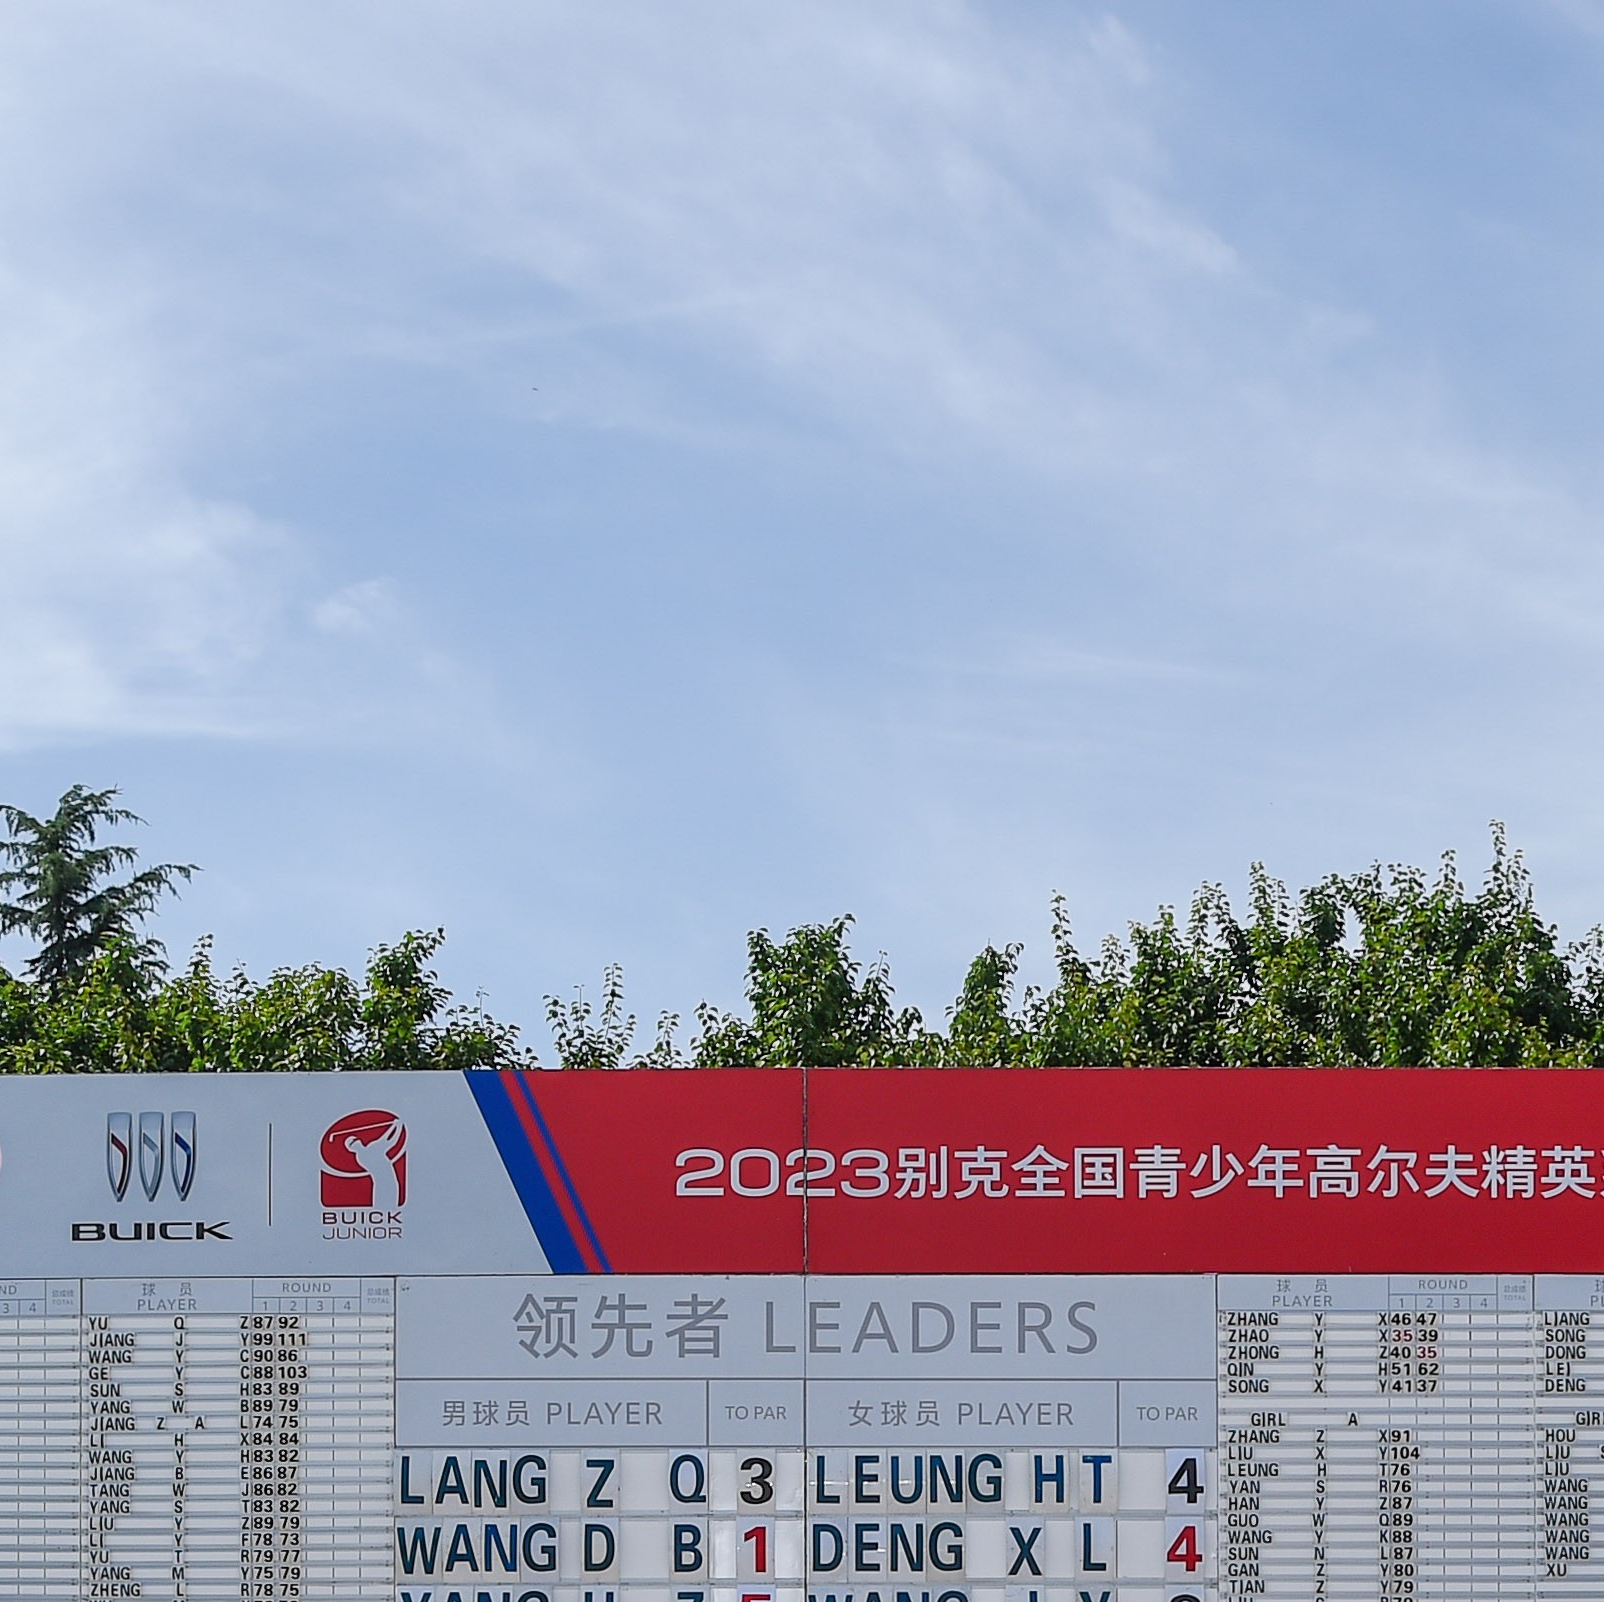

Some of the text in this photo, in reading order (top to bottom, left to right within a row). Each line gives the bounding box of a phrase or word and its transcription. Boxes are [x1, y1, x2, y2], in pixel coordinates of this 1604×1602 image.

[322, 1211, 402, 1225] BUICK
[71, 1221, 233, 1241] BUICK
[322, 1227, 402, 1240] JUNIOR
[282, 1282, 331, 1293] ROUND
[1418, 1279, 1468, 1290] ROUND
[137, 1299, 197, 1311] PLAYER
[1272, 1295, 1333, 1307] PLAYER
[1426, 1298, 1434, 1308] 2
[1453, 1298, 1460, 1308] 3
[1479, 1298, 1488, 1308] 4
[2, 1304, 10, 1314] 3
[28, 1303, 37, 1314] 4
[512, 1292, 1098, 1360] 领先者 LEADERS
[1228, 1346, 1437, 1359] ZHONG H Z 40 35
[1545, 1380, 1586, 1392] DENG
[442, 1400, 663, 1427] 男球员 PLAYER
[725, 1406, 787, 1420] TO PAR
[848, 1400, 1074, 1427] 女球员 PLAYER
[1136, 1407, 1198, 1420] TO PAR
[1251, 1413, 1358, 1426] GIRL A
[90, 1417, 299, 1430] JIANG Z A L 74 75
[1228, 1463, 1410, 1476] LEUNG H T 76
[400, 1453, 707, 1508] LANG Z Q
[739, 1457, 775, 1504] 3
[815, 1453, 1003, 1504] LEUNG
[1167, 1457, 1205, 1504] 4
[1545, 1497, 1588, 1509] WANG
[397, 1522, 703, 1575] WANG D B
[743, 1526, 768, 1573] 1
[811, 1521, 1107, 1576] DENG X L
[1166, 1525, 1203, 1573] 4
[90, 1584, 300, 1597] ZHENG L R 78 75
